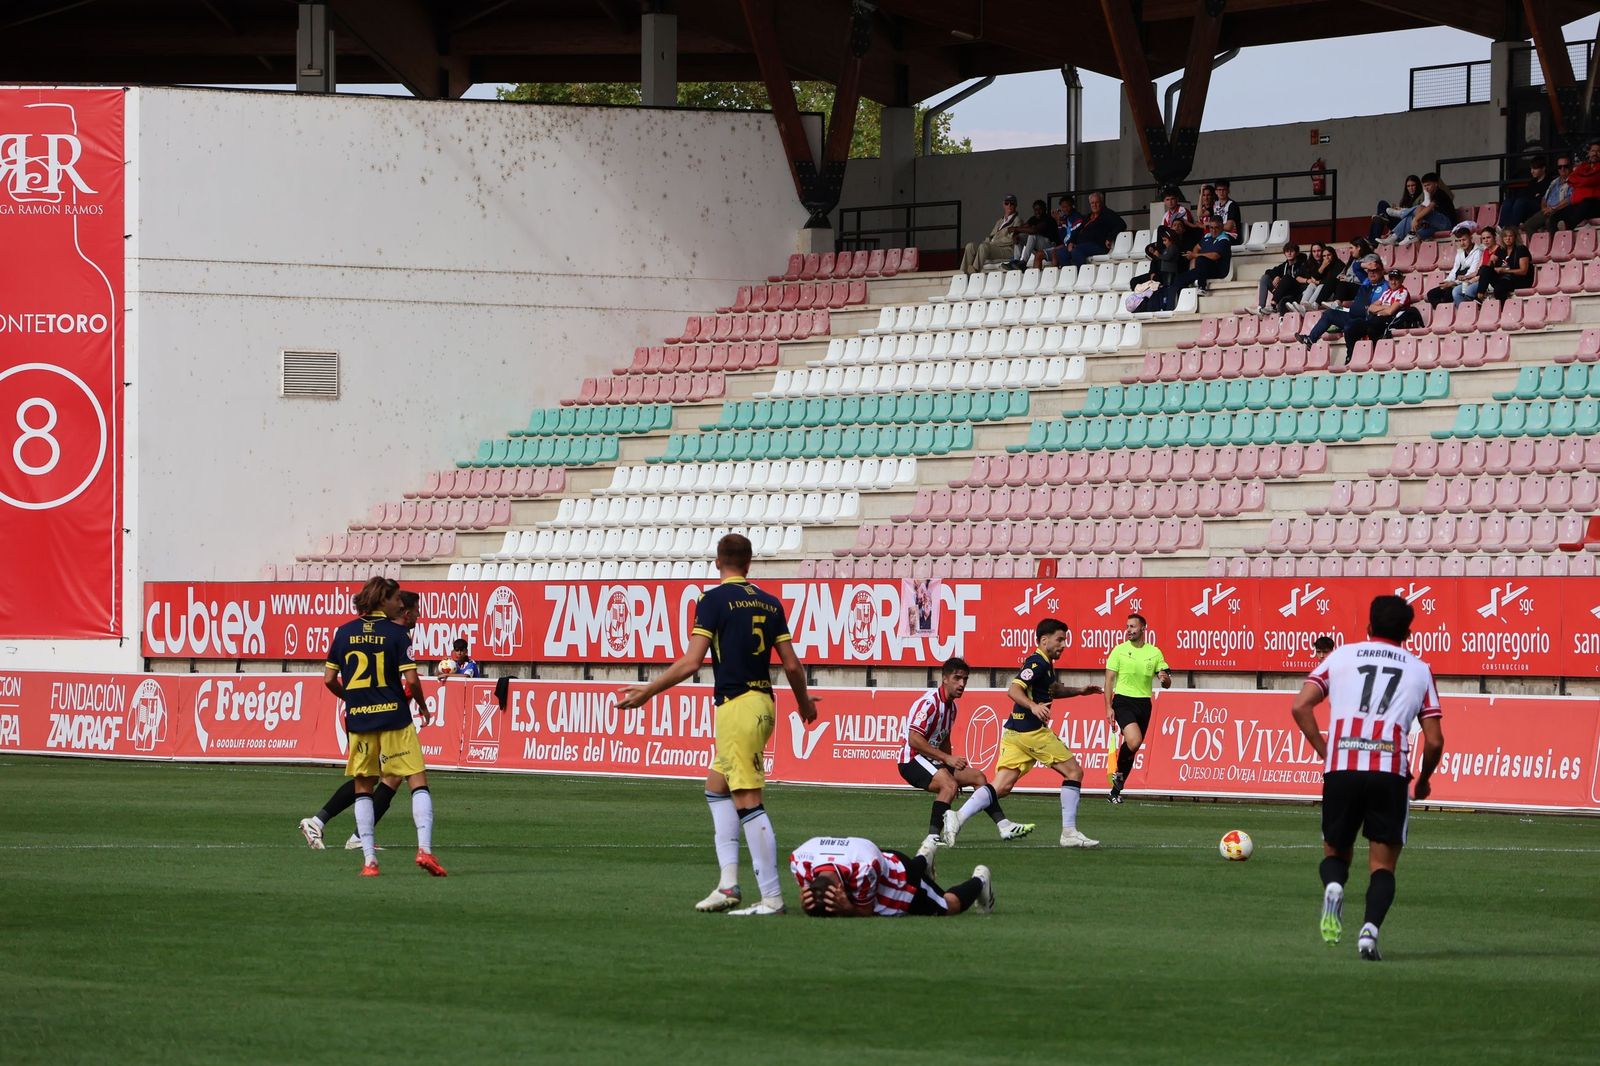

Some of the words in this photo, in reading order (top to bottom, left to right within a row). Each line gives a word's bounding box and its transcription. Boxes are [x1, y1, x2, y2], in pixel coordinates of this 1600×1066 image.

[18, 204, 61, 215] RAMON
[65, 204, 104, 215] RAMOS
[12, 397, 61, 476] 8
[418, 585, 479, 620] NDACIÓN
[1047, 598, 1060, 614] sgc
[1129, 598, 1143, 614] sgc
[1227, 598, 1241, 616] sgc
[1316, 598, 1330, 615] sgc
[1421, 597, 1436, 615] sgc
[1519, 597, 1534, 616] sgc
[349, 634, 386, 645] BENEIT
[752, 615, 767, 656] 5
[1176, 625, 1255, 657] sangregorio
[1461, 625, 1550, 661] sangregorio
[1356, 649, 1408, 664] CARBONELL
[344, 650, 388, 690] 21
[50, 677, 126, 713] FUNDACIÓN
[1356, 664, 1404, 716] 17
[214, 679, 304, 732] Freigel
[511, 690, 541, 733] E.S.
[547, 690, 619, 735] CAMINO
[651, 694, 673, 737] LA
[1192, 701, 1228, 724] PAGO
[209, 738, 215, 748] A
[216, 739, 245, 749] GOODLIFE
[246, 739, 266, 749] FOODS
[267, 739, 298, 749] COMPANY
[523, 736, 579, 761] Morales
[582, 737, 606, 762] del
[610, 740, 640, 764] Vino
[645, 741, 716, 769] (Zamora)
[832, 748, 842, 759] EL
[843, 749, 870, 759] CENTRO
[1178, 763, 1212, 781] QUESO
[1212, 767, 1224, 780] DE
[1227, 764, 1256, 783] OVEJA
[1262, 770, 1291, 783] LECHE
